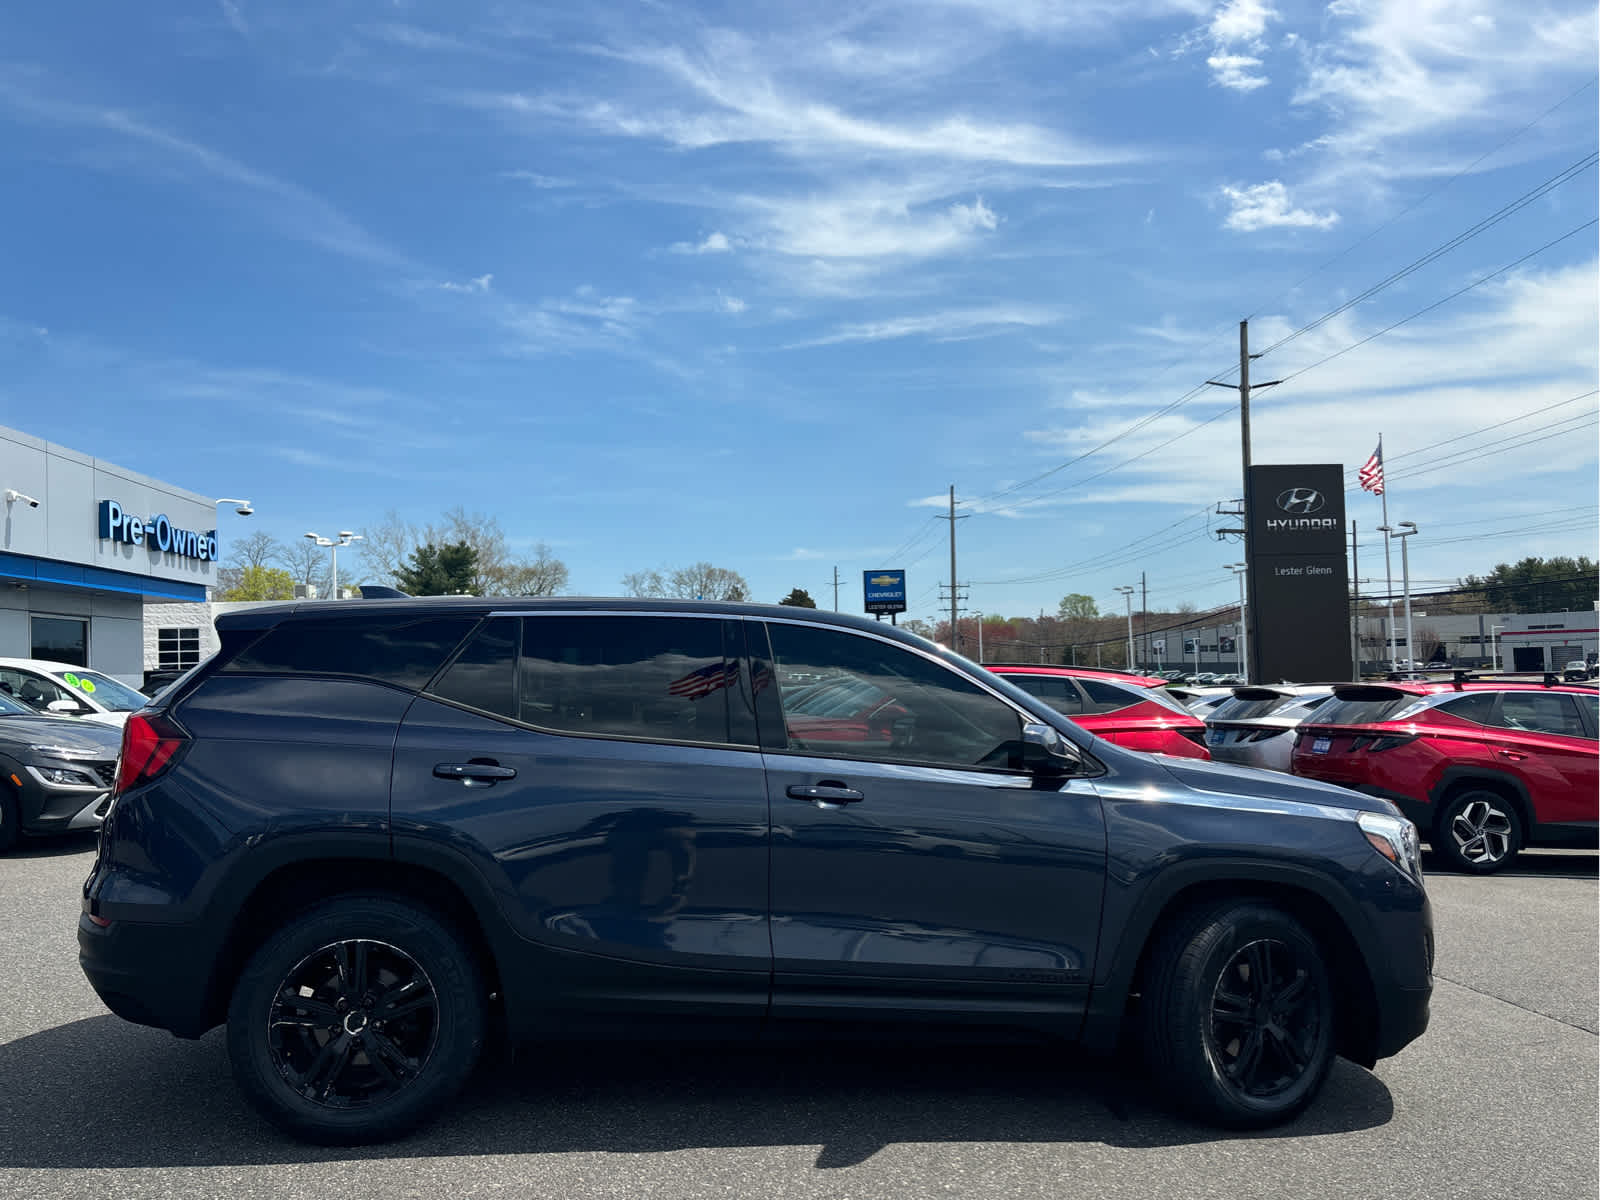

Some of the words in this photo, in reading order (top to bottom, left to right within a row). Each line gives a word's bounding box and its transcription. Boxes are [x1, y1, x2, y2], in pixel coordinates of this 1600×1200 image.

[1266, 518, 1337, 530] HYUNDAI
[99, 500, 219, 562] Pre-Owned
[1275, 566, 1303, 576] Lester
[1306, 565, 1333, 575] Glenn
[867, 591, 903, 599] CHEVROLET
